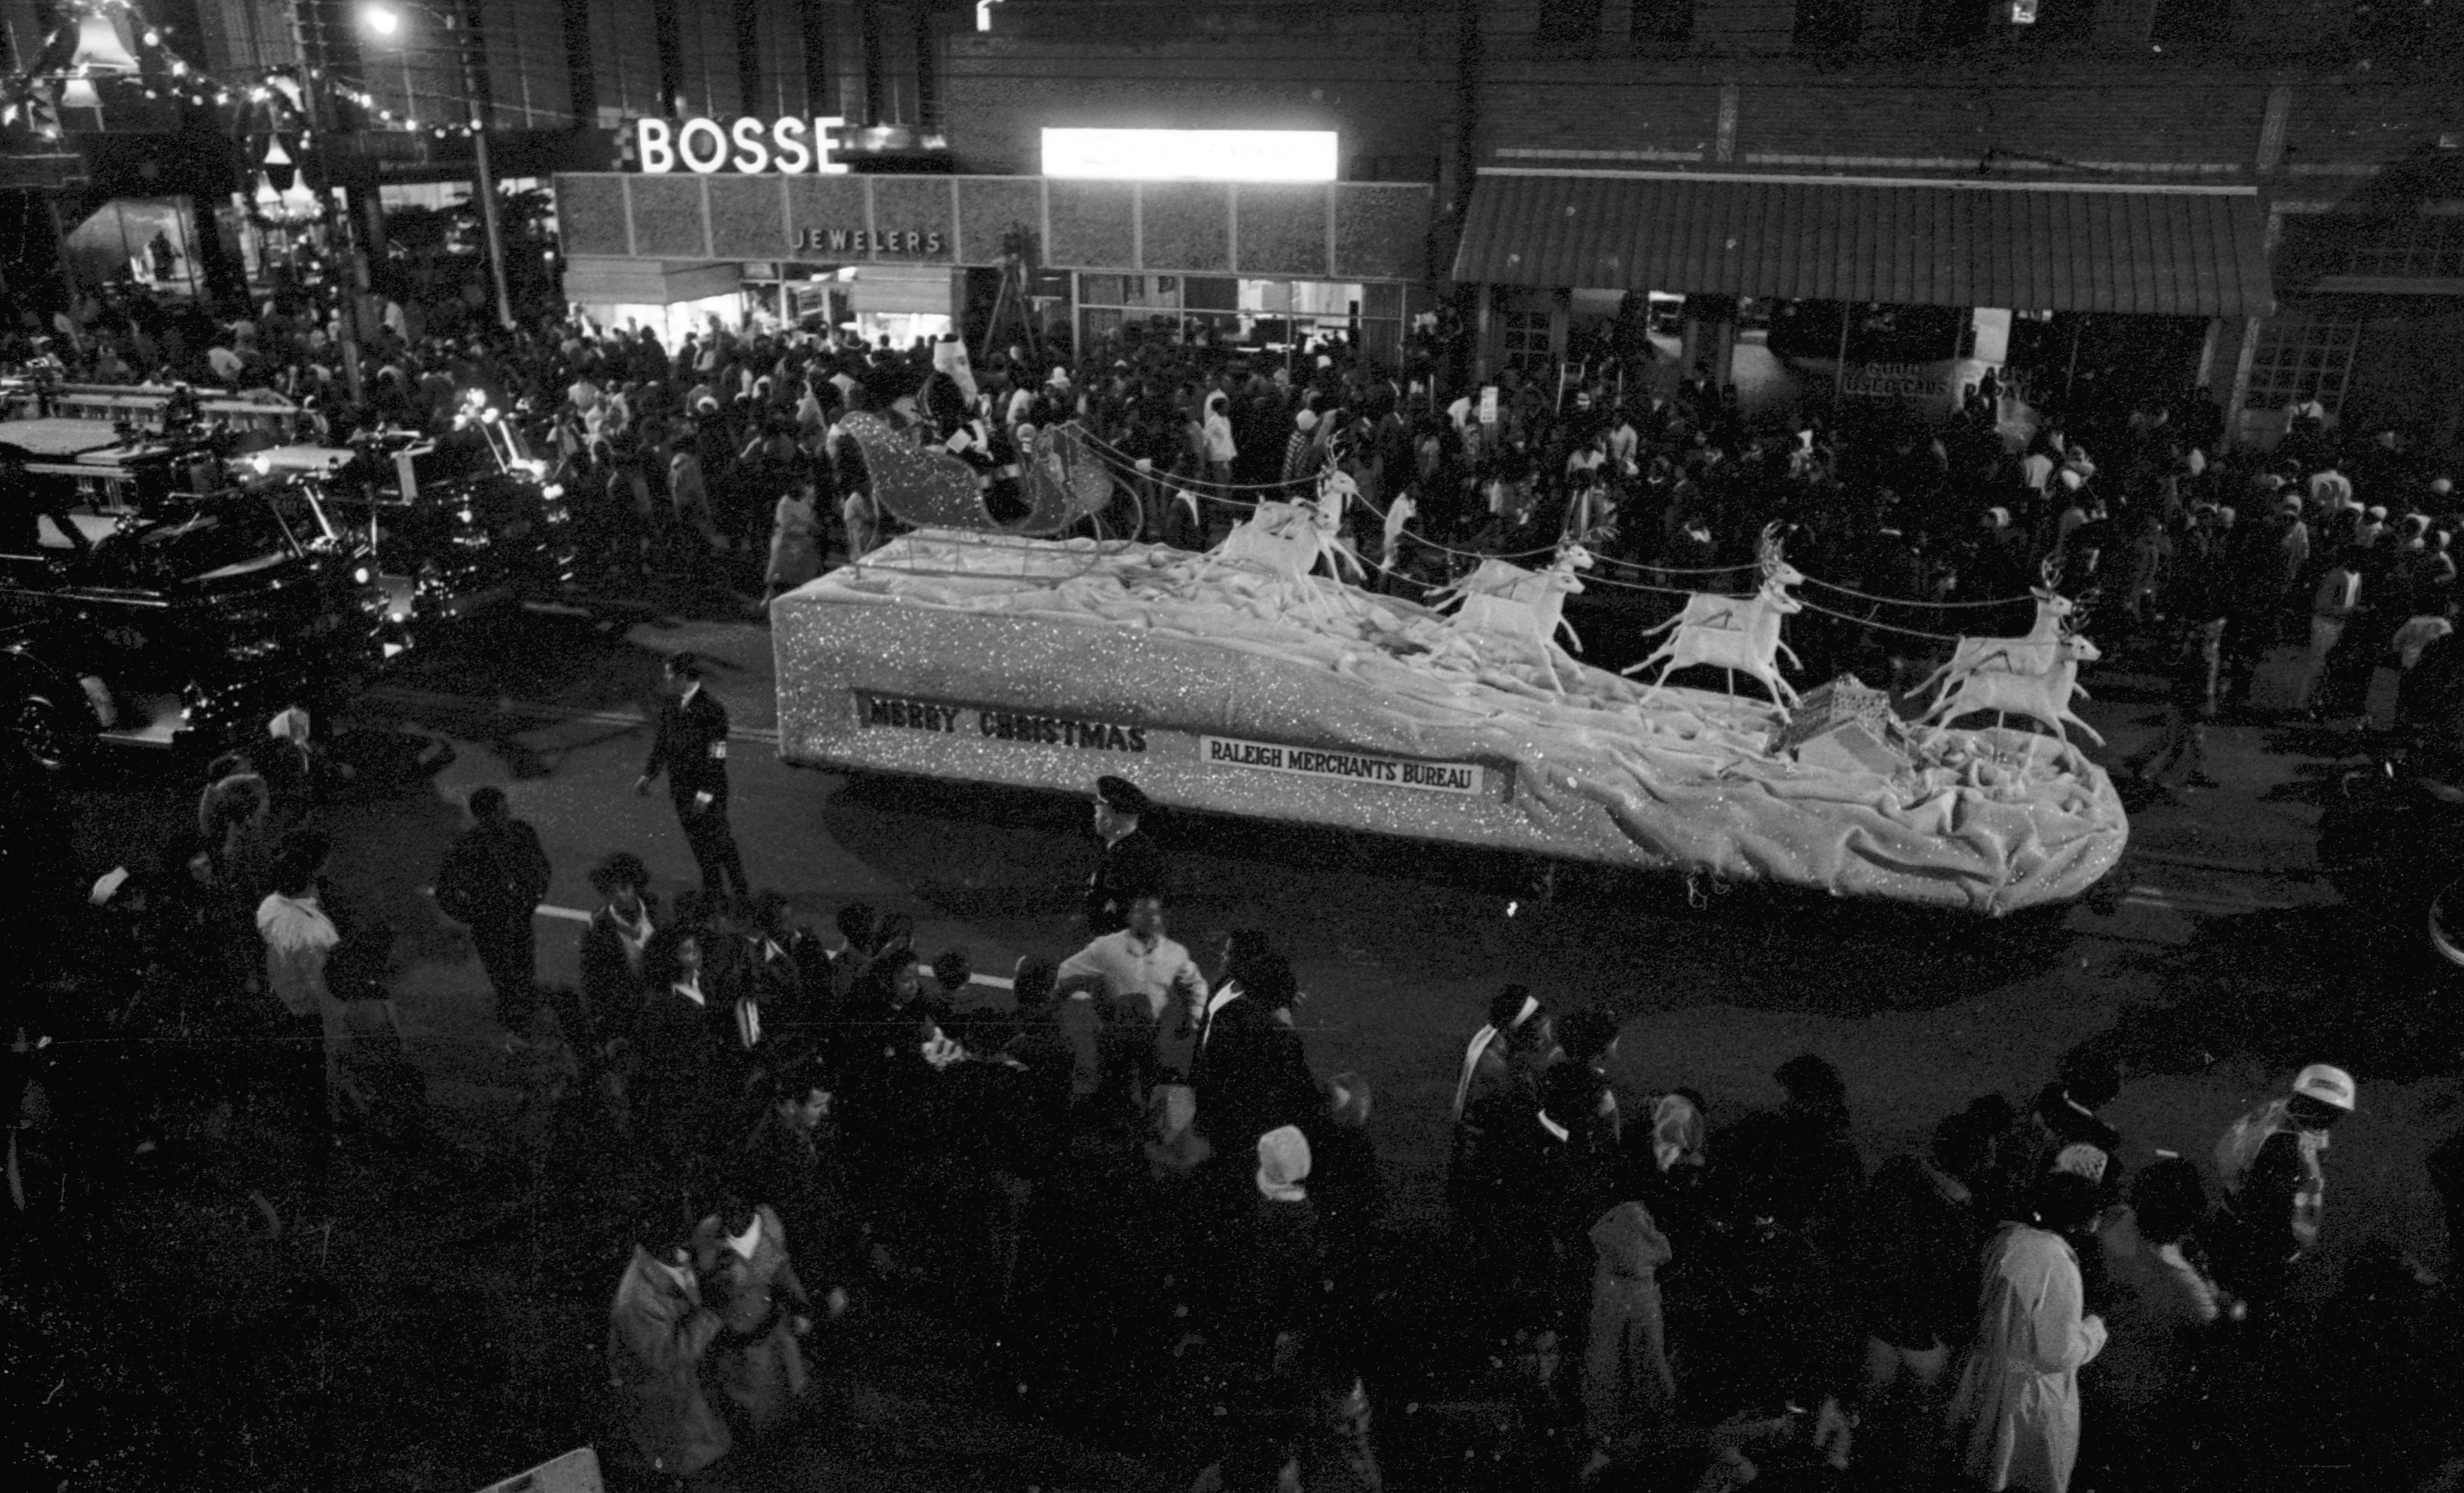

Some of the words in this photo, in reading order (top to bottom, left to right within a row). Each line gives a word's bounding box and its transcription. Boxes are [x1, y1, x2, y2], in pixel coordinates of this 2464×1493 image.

[638, 116, 849, 174] BOSSE
[793, 228, 940, 252] JEWELERS
[868, 700, 959, 733] MERRY
[978, 710, 1147, 753] CHRISTMAS
[1210, 740, 1282, 768] RALEIGH
[1287, 750, 1396, 781] MERCHANTS
[1402, 763, 1472, 789] BUREAU
